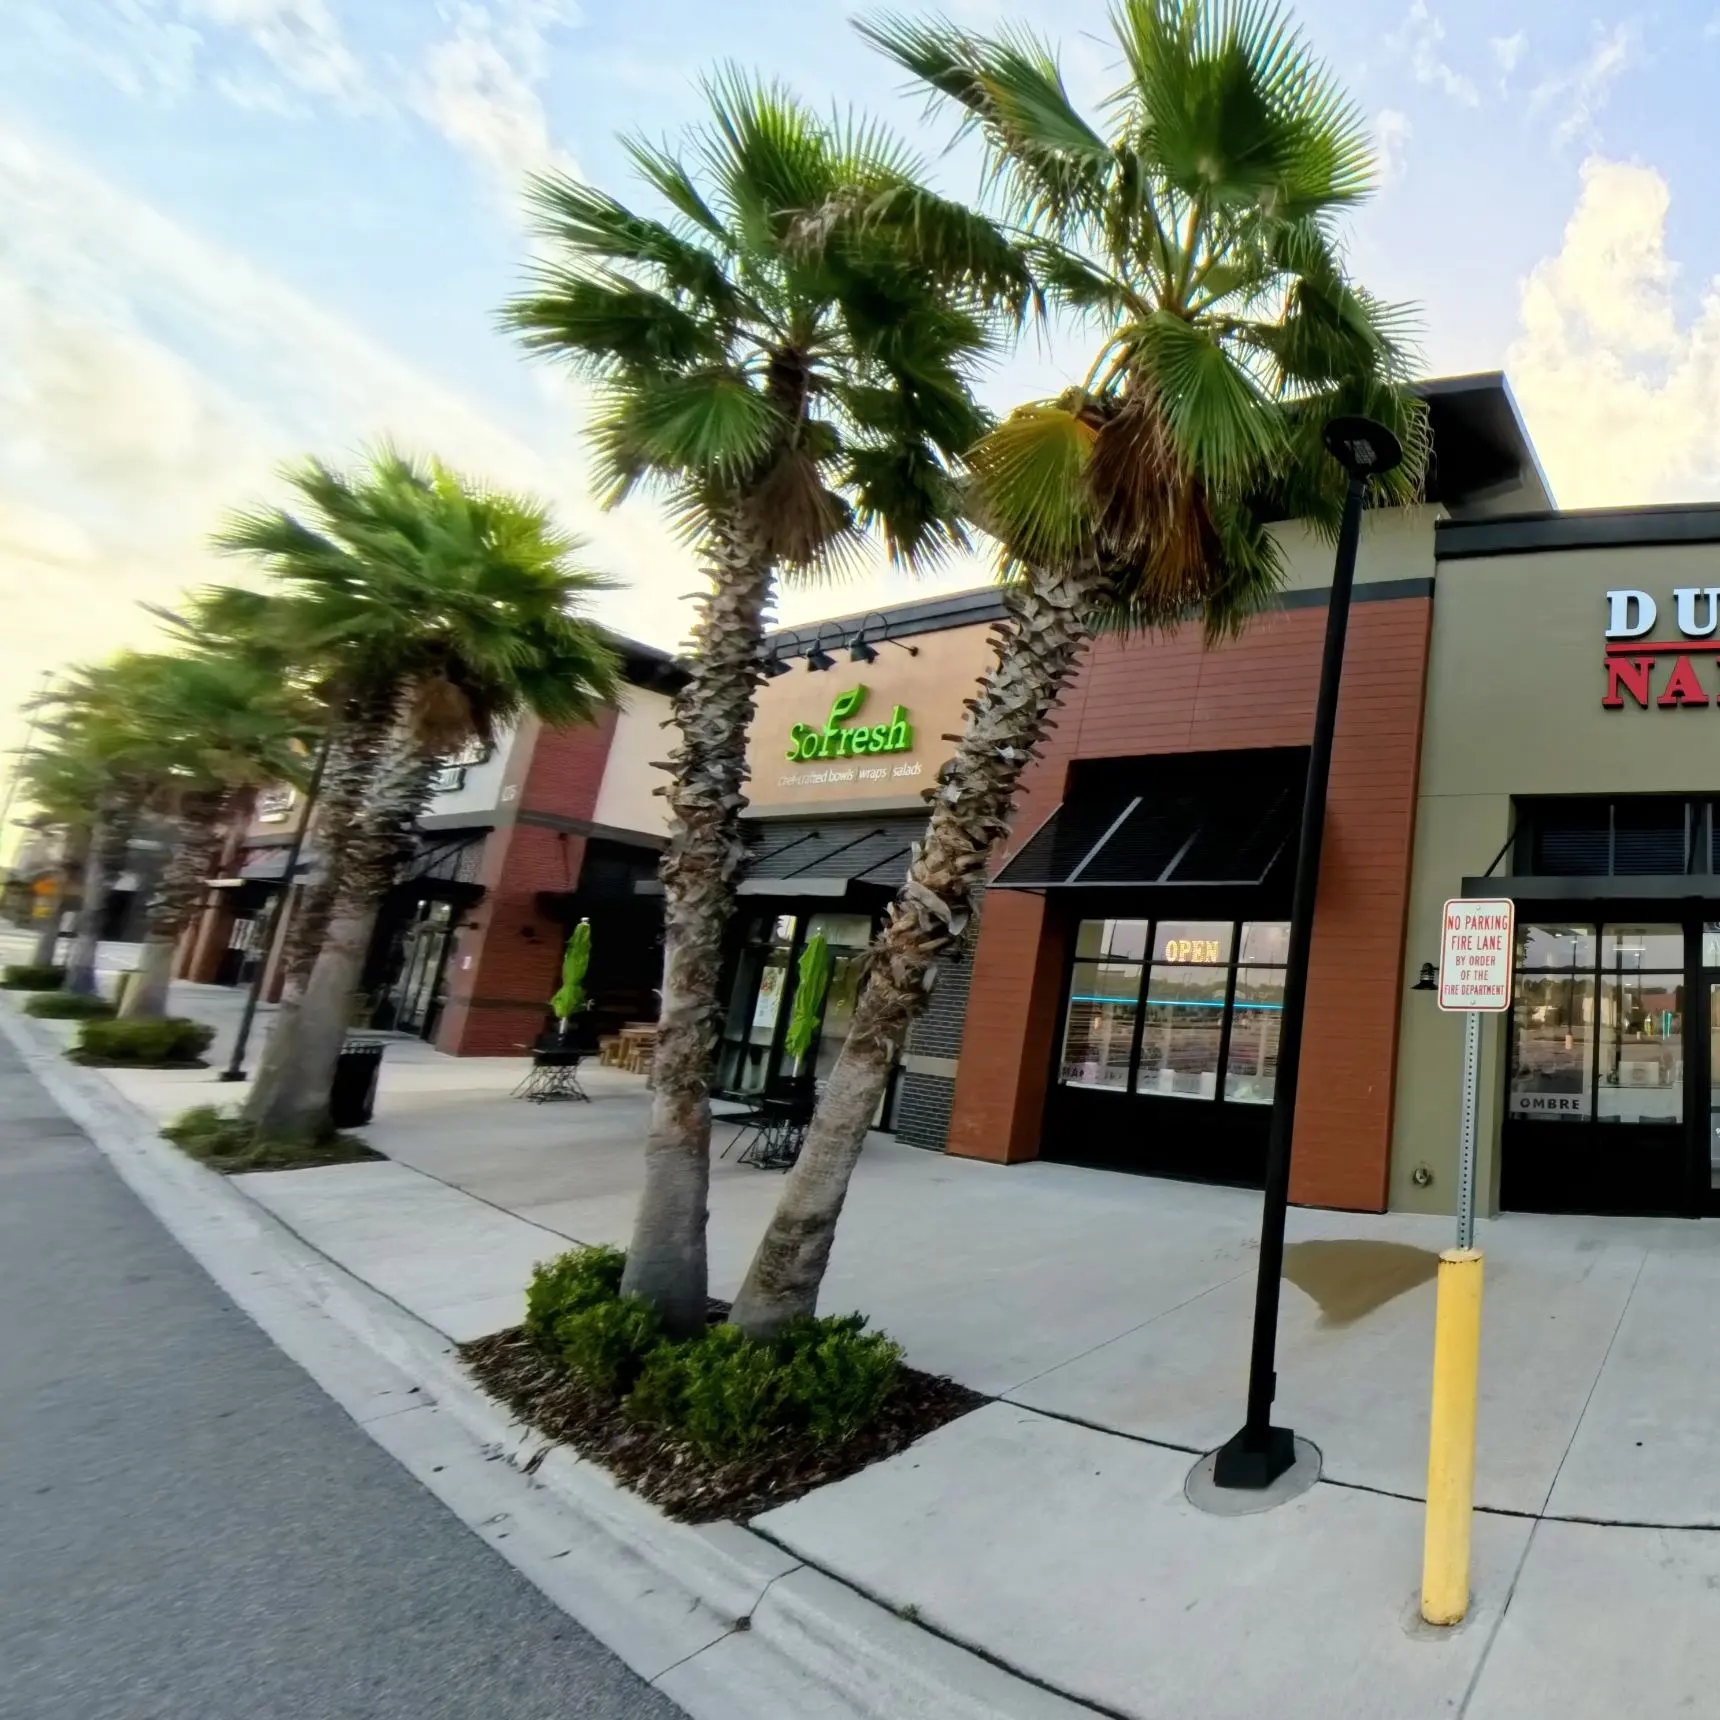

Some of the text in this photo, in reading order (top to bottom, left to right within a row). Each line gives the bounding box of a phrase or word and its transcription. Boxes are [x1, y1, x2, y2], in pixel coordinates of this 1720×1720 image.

[828, 767, 855, 783] bowls
[858, 767, 888, 783] wraps
[892, 762, 923, 777] salads
[1447, 915, 1509, 931] NO PARKING
[1451, 935, 1503, 951] FIRE LANE
[1165, 939, 1220, 963] OPEN
[1455, 955, 1497, 967] BY ORDER
[1460, 969, 1489, 981] OF THE
[1444, 983, 1505, 996] FIRE DEPARTMENT
[1519, 1098, 1580, 1110] OMBRE
